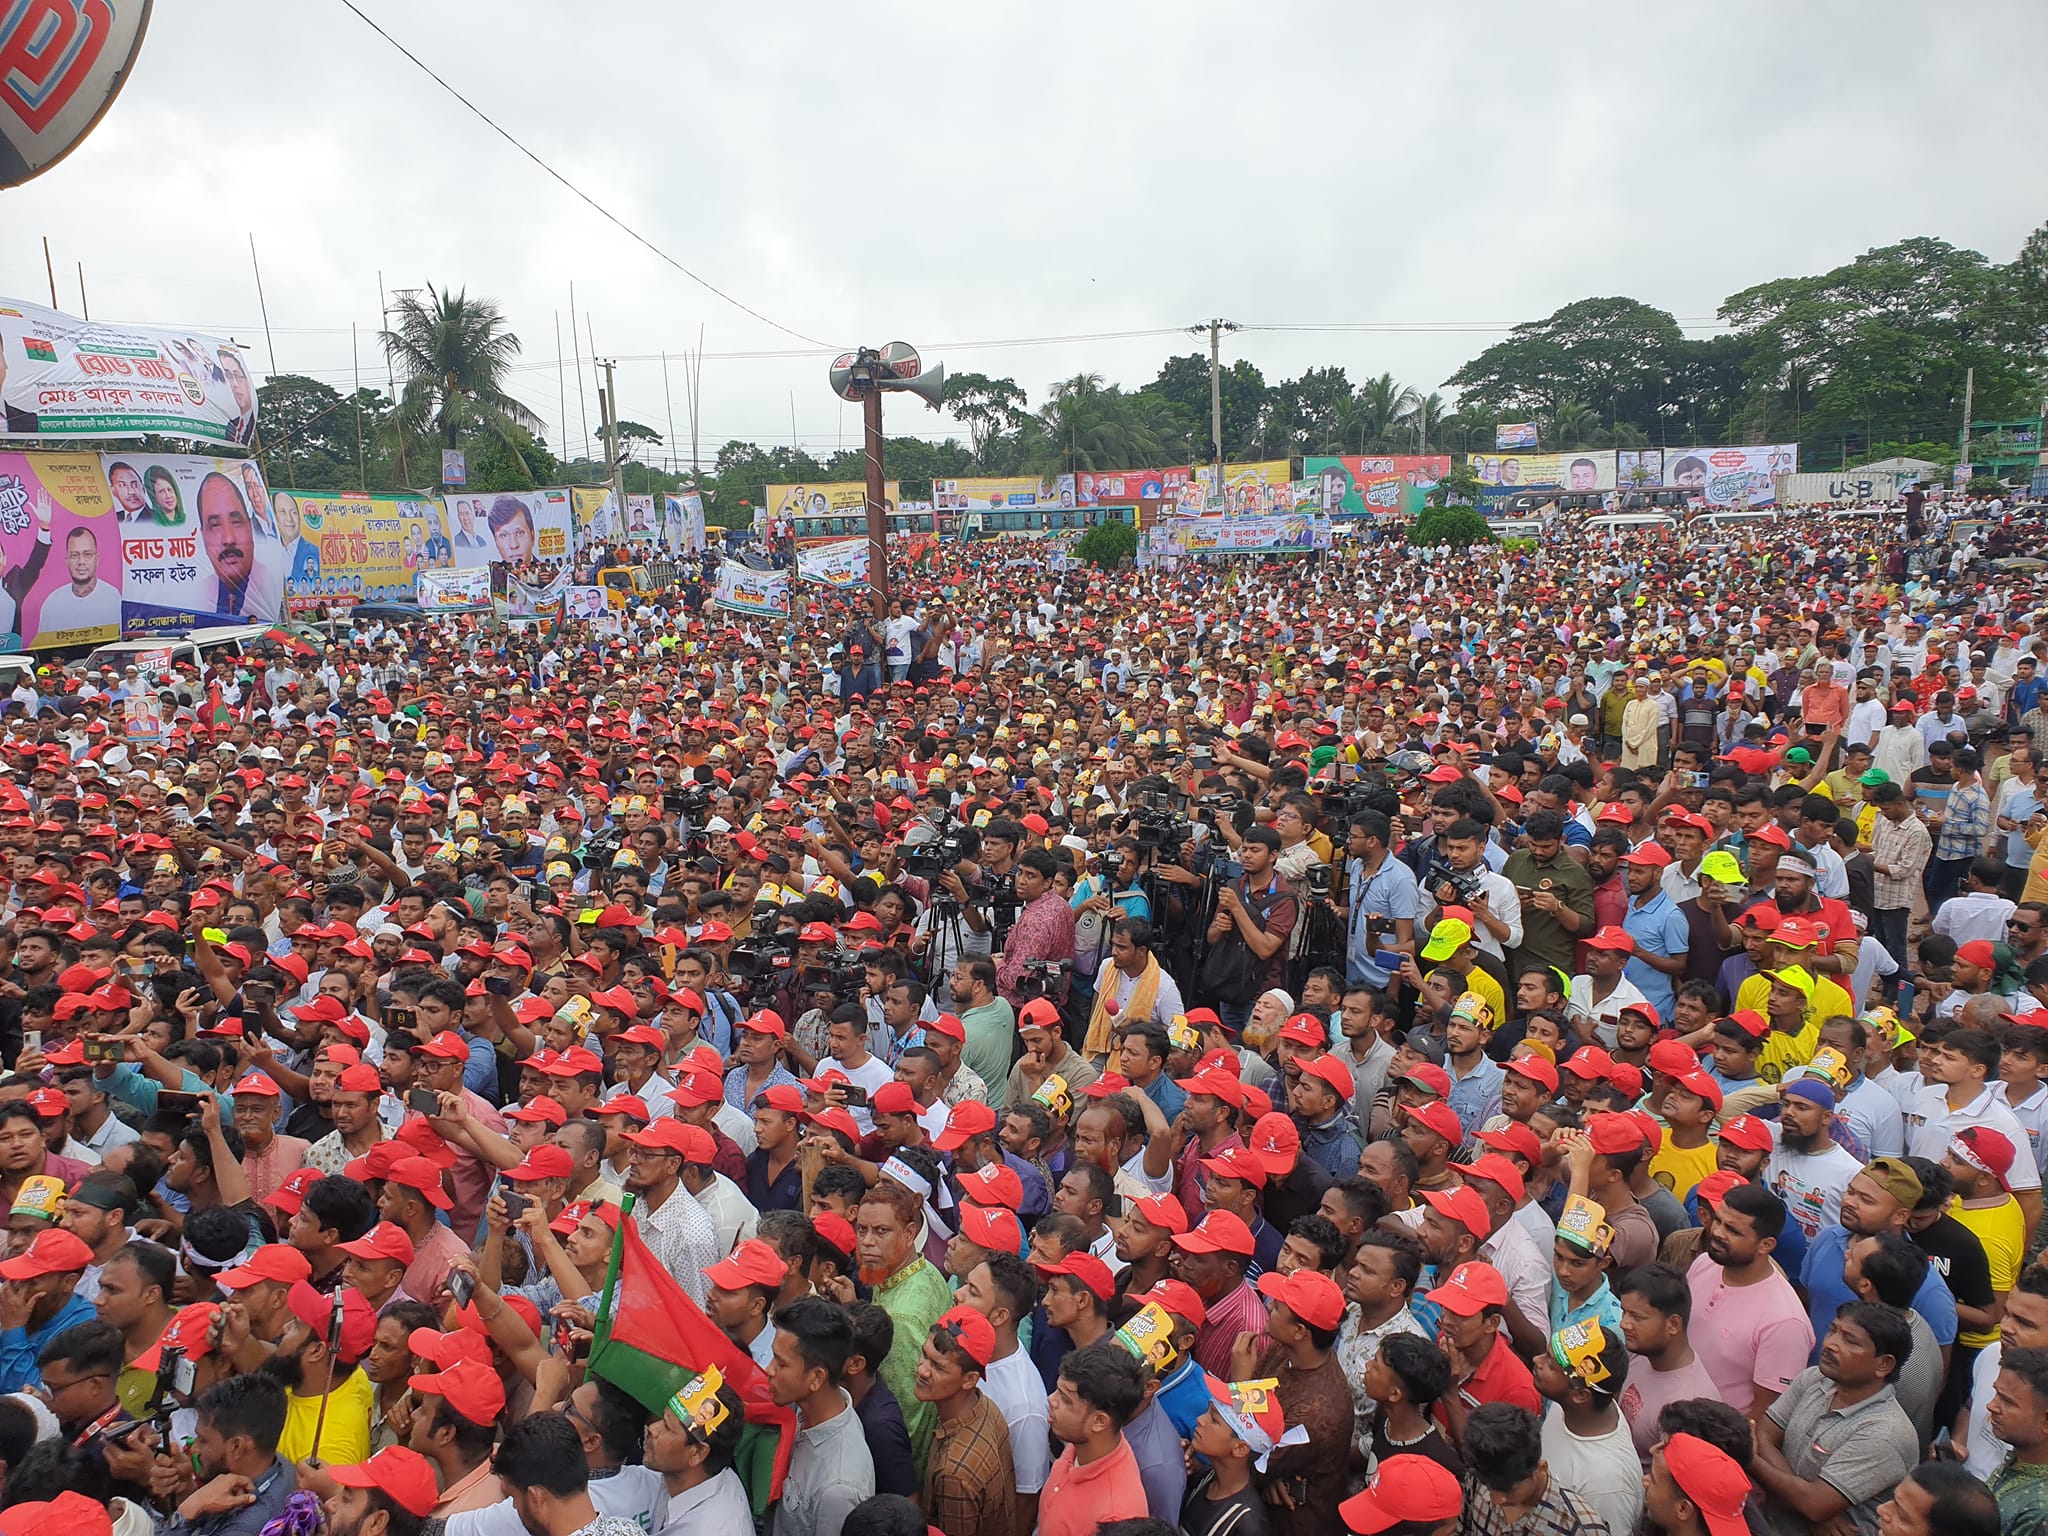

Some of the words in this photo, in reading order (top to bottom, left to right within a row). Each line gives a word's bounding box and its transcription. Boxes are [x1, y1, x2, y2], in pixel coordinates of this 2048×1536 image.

[74, 354, 133, 376] রোড
[82, 387, 133, 406] আবুল
[136, 390, 185, 407] কালাম
[122, 538, 165, 565] রোড
[166, 528, 199, 559] মার্চ
[130, 567, 165, 584] সফল
[166, 561, 197, 583] হউক
